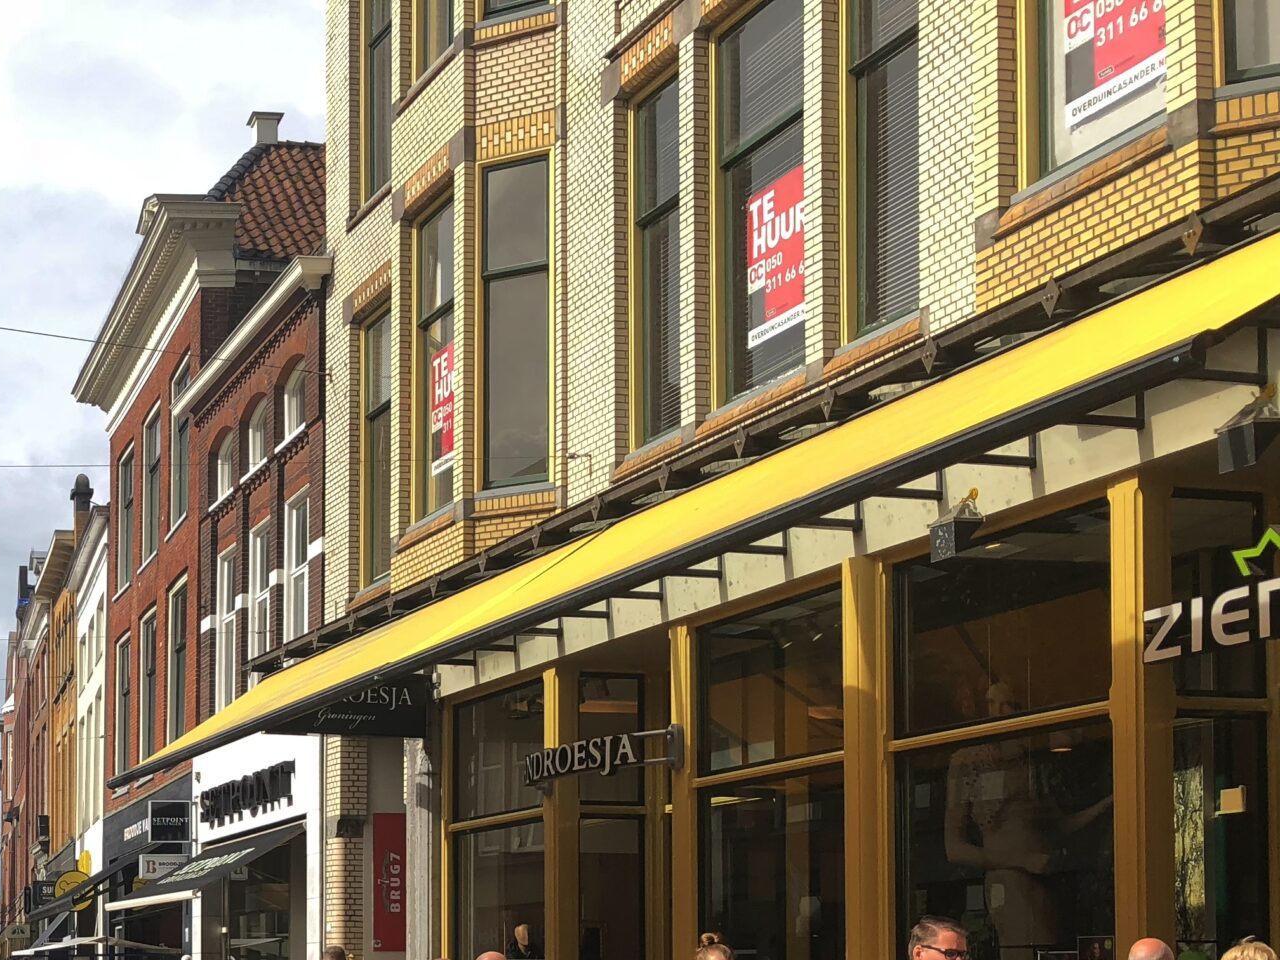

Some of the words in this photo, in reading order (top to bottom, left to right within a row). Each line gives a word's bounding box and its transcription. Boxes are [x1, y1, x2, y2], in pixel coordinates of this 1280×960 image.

[1096, 16, 1124, 46] 311
[1129, 1, 1149, 27] 66
[749, 189, 775, 230] TE
[752, 202, 805, 259] HUUR
[766, 252, 783, 272] 050
[765, 272, 782, 293] 311
[785, 264, 797, 283] 66
[433, 351, 448, 382] TE
[313, 707, 376, 730] Groningen
